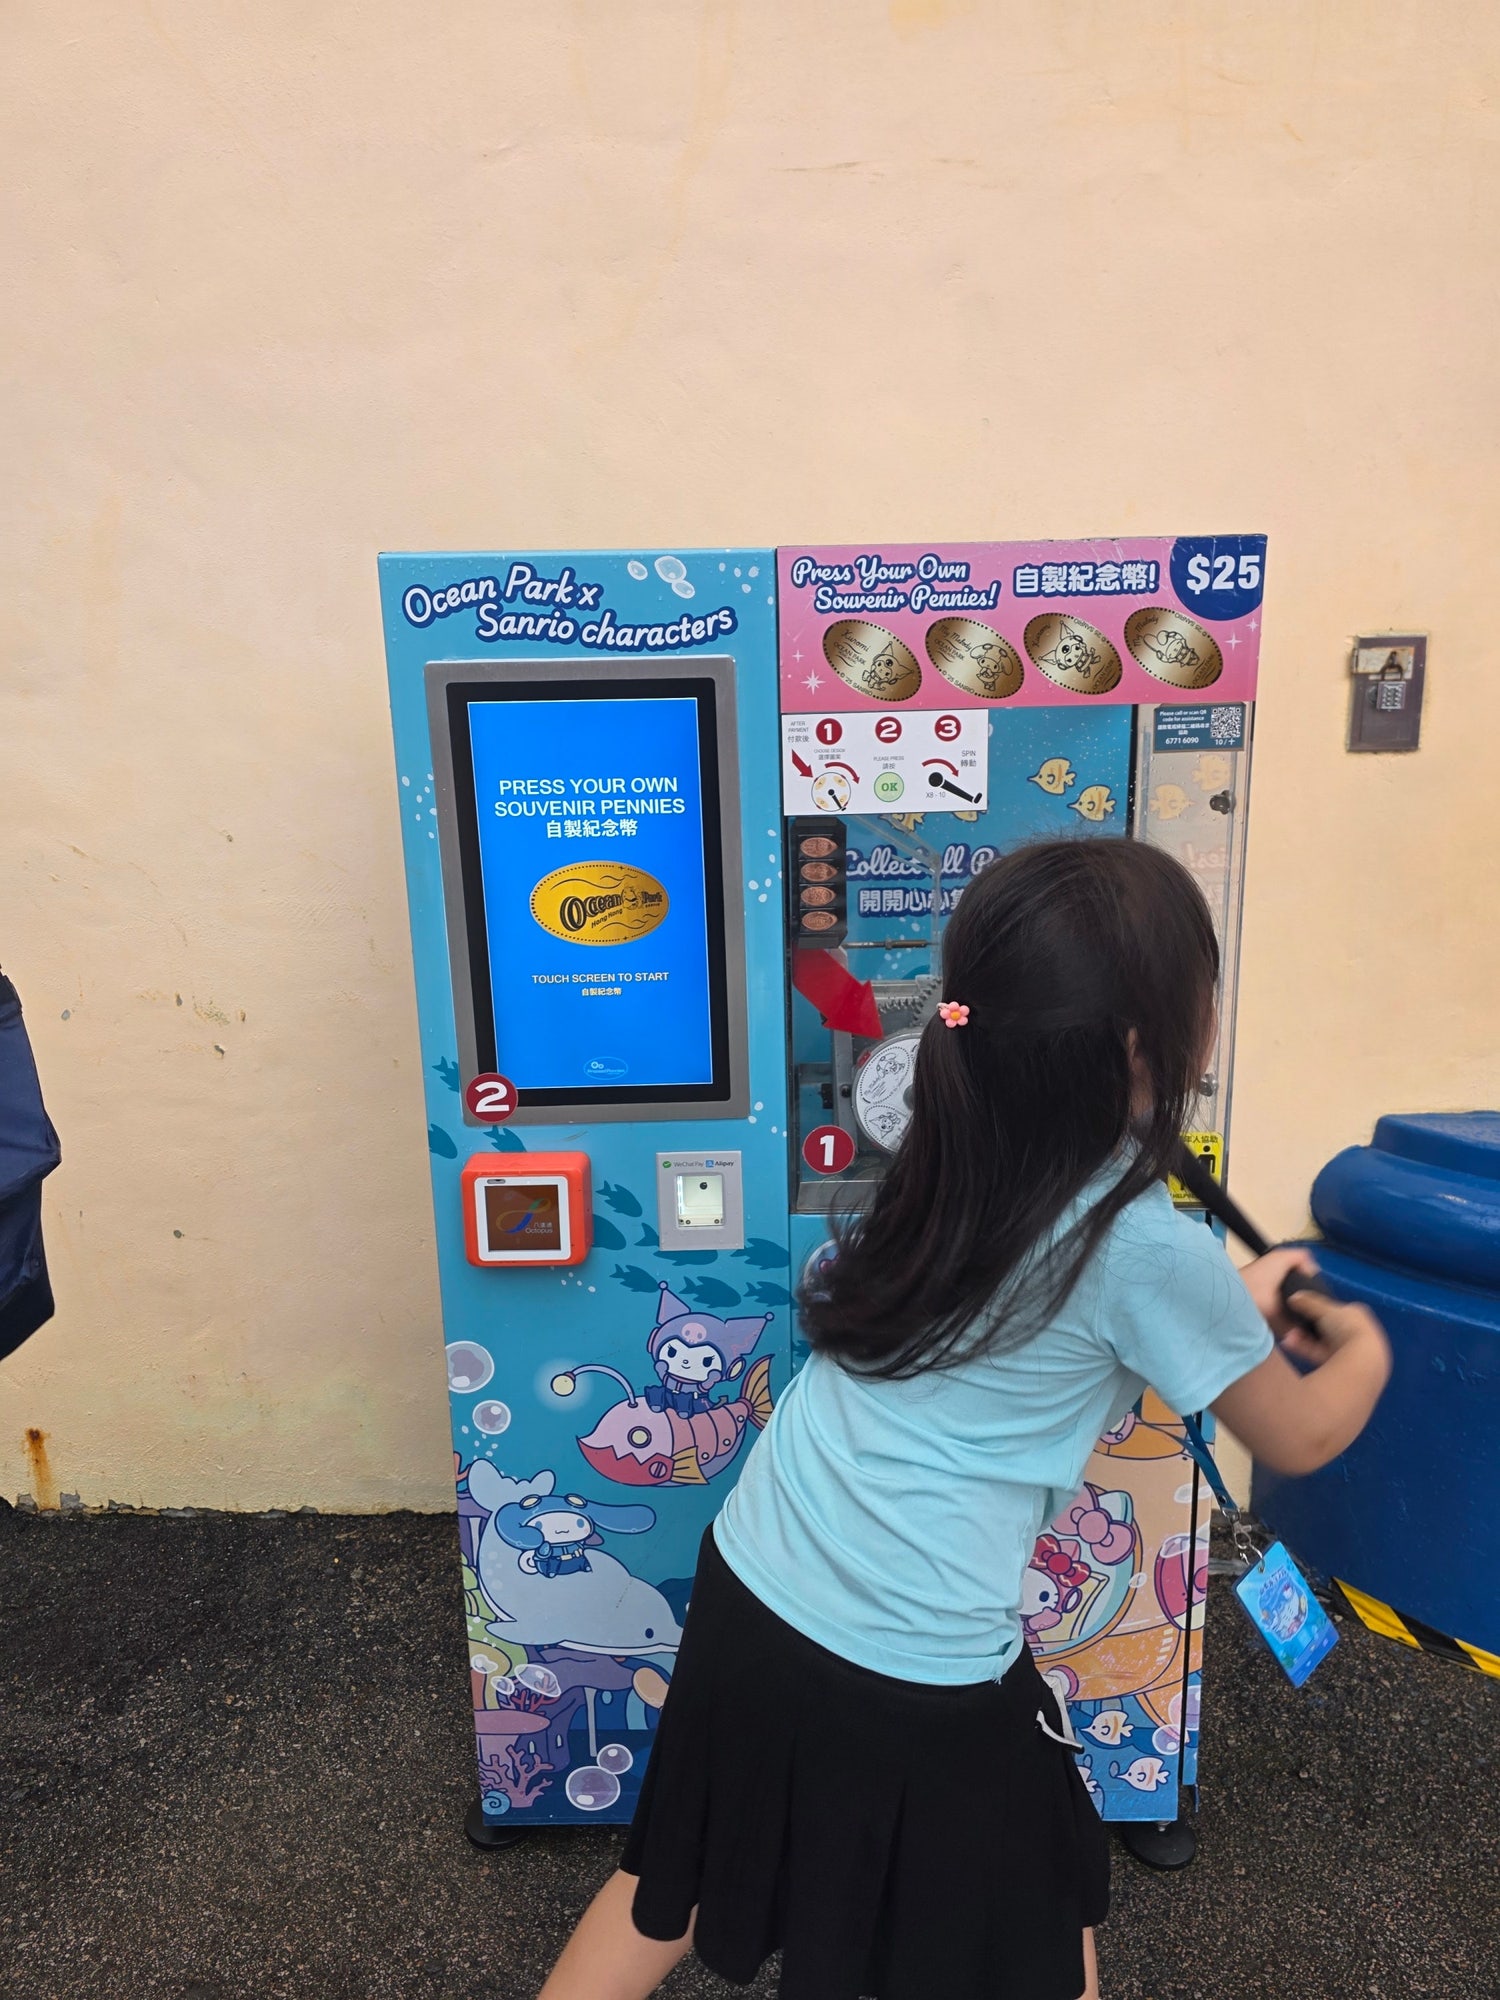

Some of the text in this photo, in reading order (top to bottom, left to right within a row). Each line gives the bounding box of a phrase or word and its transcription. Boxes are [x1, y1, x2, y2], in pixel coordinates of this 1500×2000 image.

[792, 556, 967, 589] Press Your Own
[1015, 562, 1156, 594] 自製紀念幣!
[1186, 553, 1261, 595] $25
[404, 577, 497, 623] Ocean
[505, 564, 571, 604] Park
[815, 582, 998, 611] Souvenir Pennies!
[478, 603, 733, 647] Sanrio characters
[841, 628, 872, 652] Kuromi
[950, 632, 973, 653] Melody
[823, 722, 833, 741] 1
[879, 720, 898, 738] 2
[938, 719, 958, 738] 3
[787, 735, 810, 743] 付款後
[1165, 736, 1199, 745] 6771 6090
[960, 759, 977, 768] 轉動
[961, 750, 976, 758] SPIN
[882, 762, 896, 770] 請按
[499, 776, 678, 796] PRESS YOUR OWN
[881, 782, 898, 792] OK
[494, 797, 686, 817] SOUVENIR PENNIES
[546, 818, 638, 839] 自製紀念幣
[559, 893, 622, 933] Ocean
[591, 908, 624, 929] Hong Kong
[531, 971, 669, 984] TOUCH SCREEN TO START
[581, 987, 623, 997] 自製紀念幣
[474, 1080, 510, 1113] 2
[818, 1134, 836, 1167] 1
[673, 1160, 695, 1168] WeChat
[714, 1160, 735, 1168] Alipay
